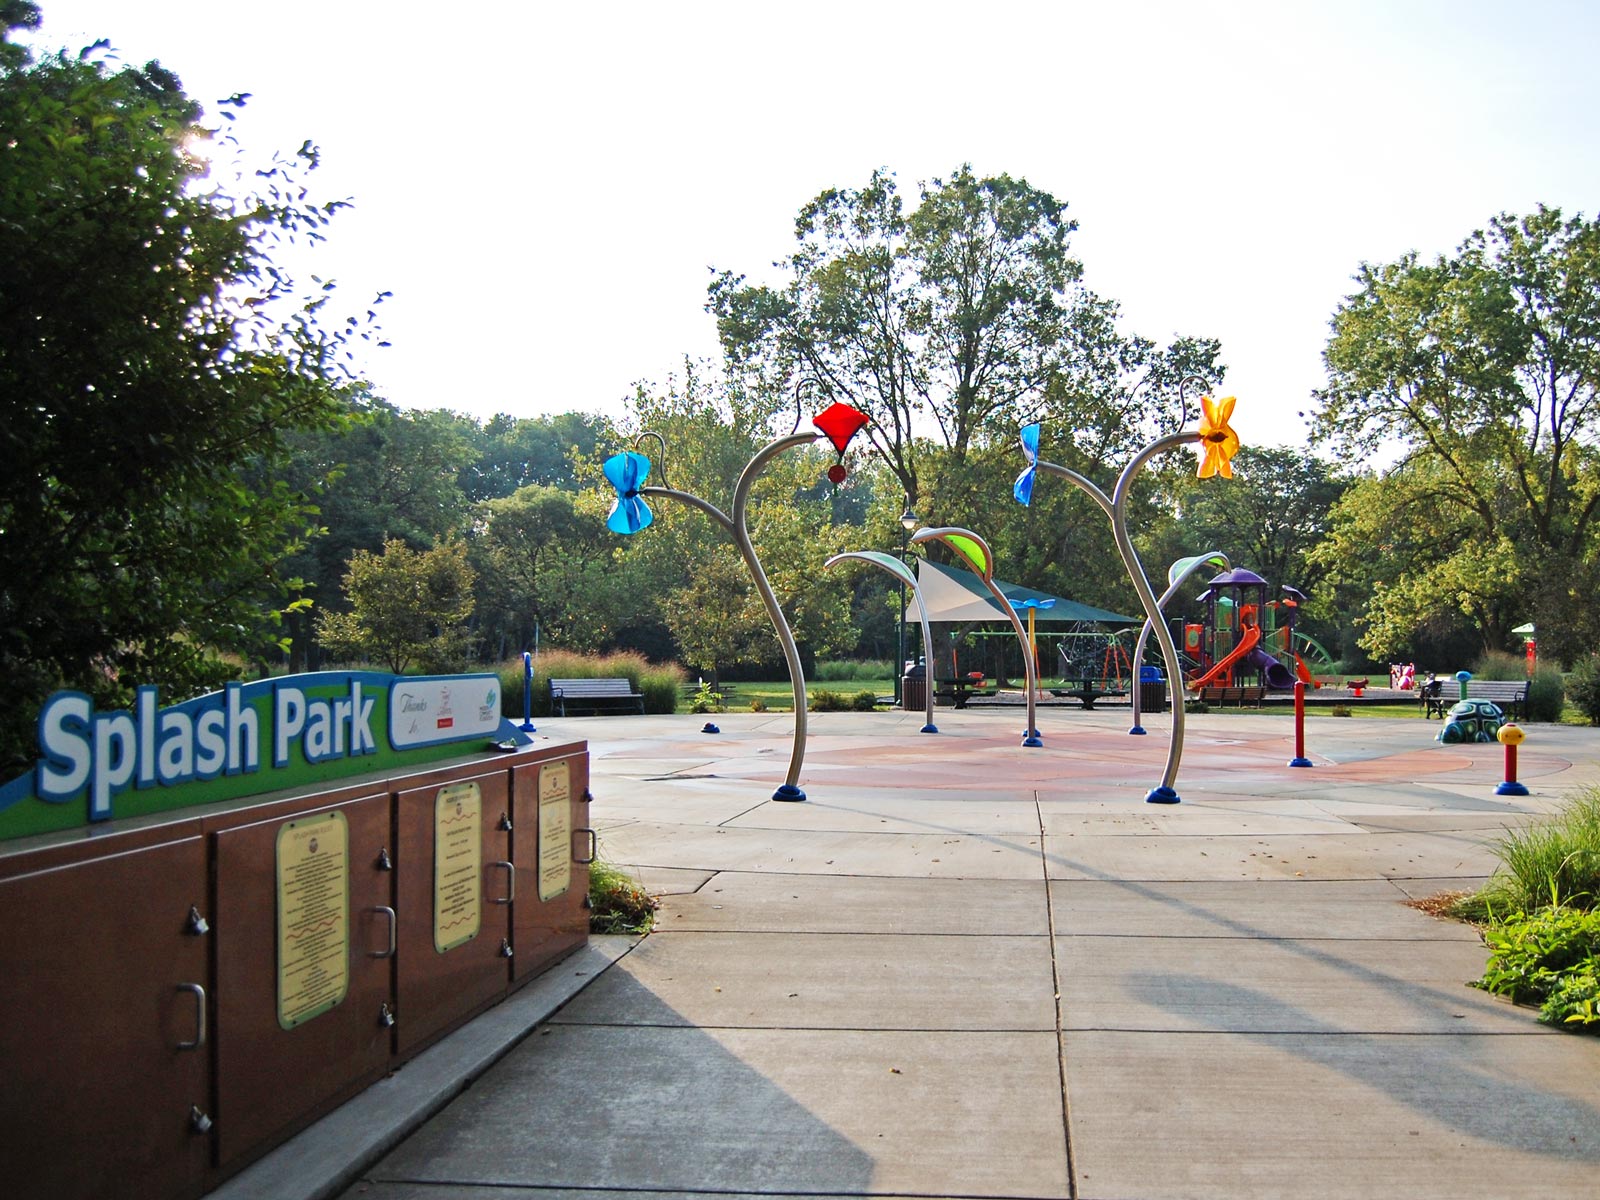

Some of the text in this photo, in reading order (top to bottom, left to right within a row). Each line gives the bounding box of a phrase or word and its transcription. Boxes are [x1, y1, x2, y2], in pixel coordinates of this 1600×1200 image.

[400, 693, 428, 713] Thanks
[41, 680, 375, 813] Splash Park
